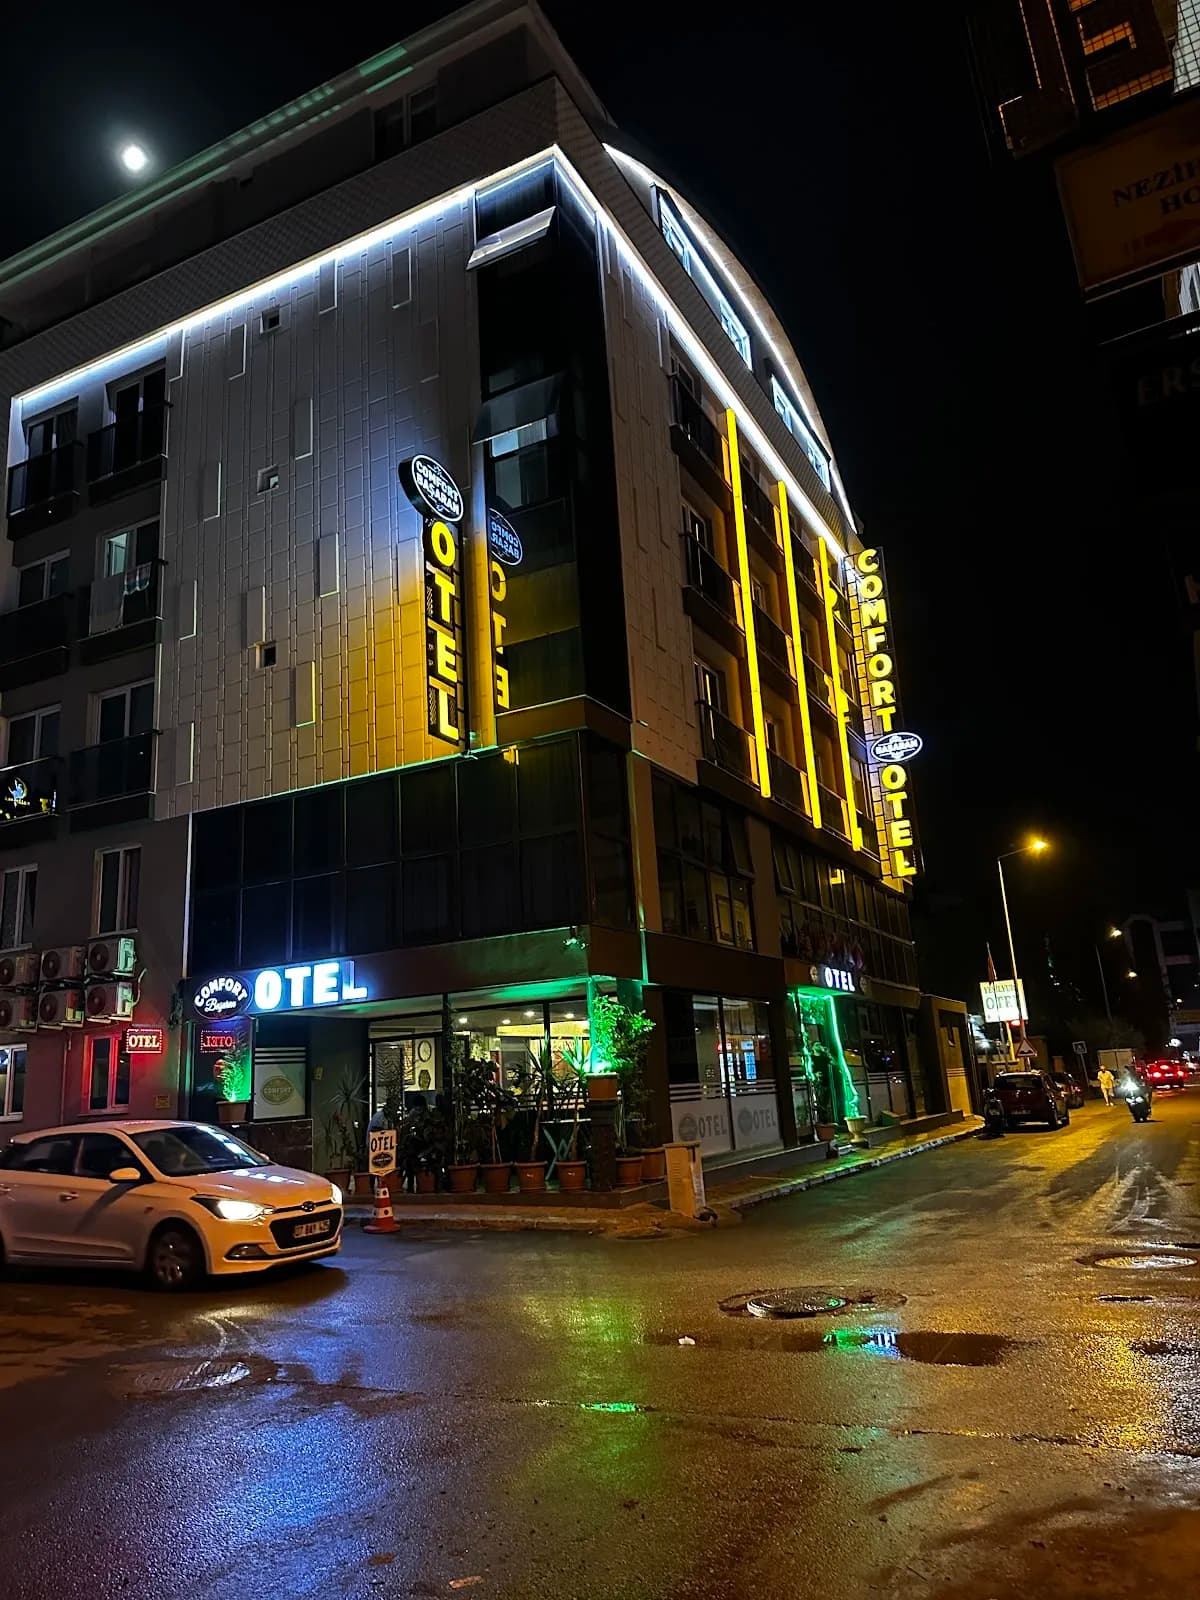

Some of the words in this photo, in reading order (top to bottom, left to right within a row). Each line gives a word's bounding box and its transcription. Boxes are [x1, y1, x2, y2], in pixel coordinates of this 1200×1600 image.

[415, 460, 460, 503] COMFORT
[431, 521, 460, 741] OTEL
[857, 548, 897, 733] COMFORT
[881, 764, 917, 877] OTEL
[194, 978, 248, 1007] COMFORT
[254, 962, 368, 1010] OTEL
[825, 966, 856, 992] OTEL
[128, 1035, 160, 1048] OTEL
[698, 1114, 728, 1138] OTEL
[752, 1107, 777, 1129] OTEL
[371, 1135, 394, 1152] OTEL
